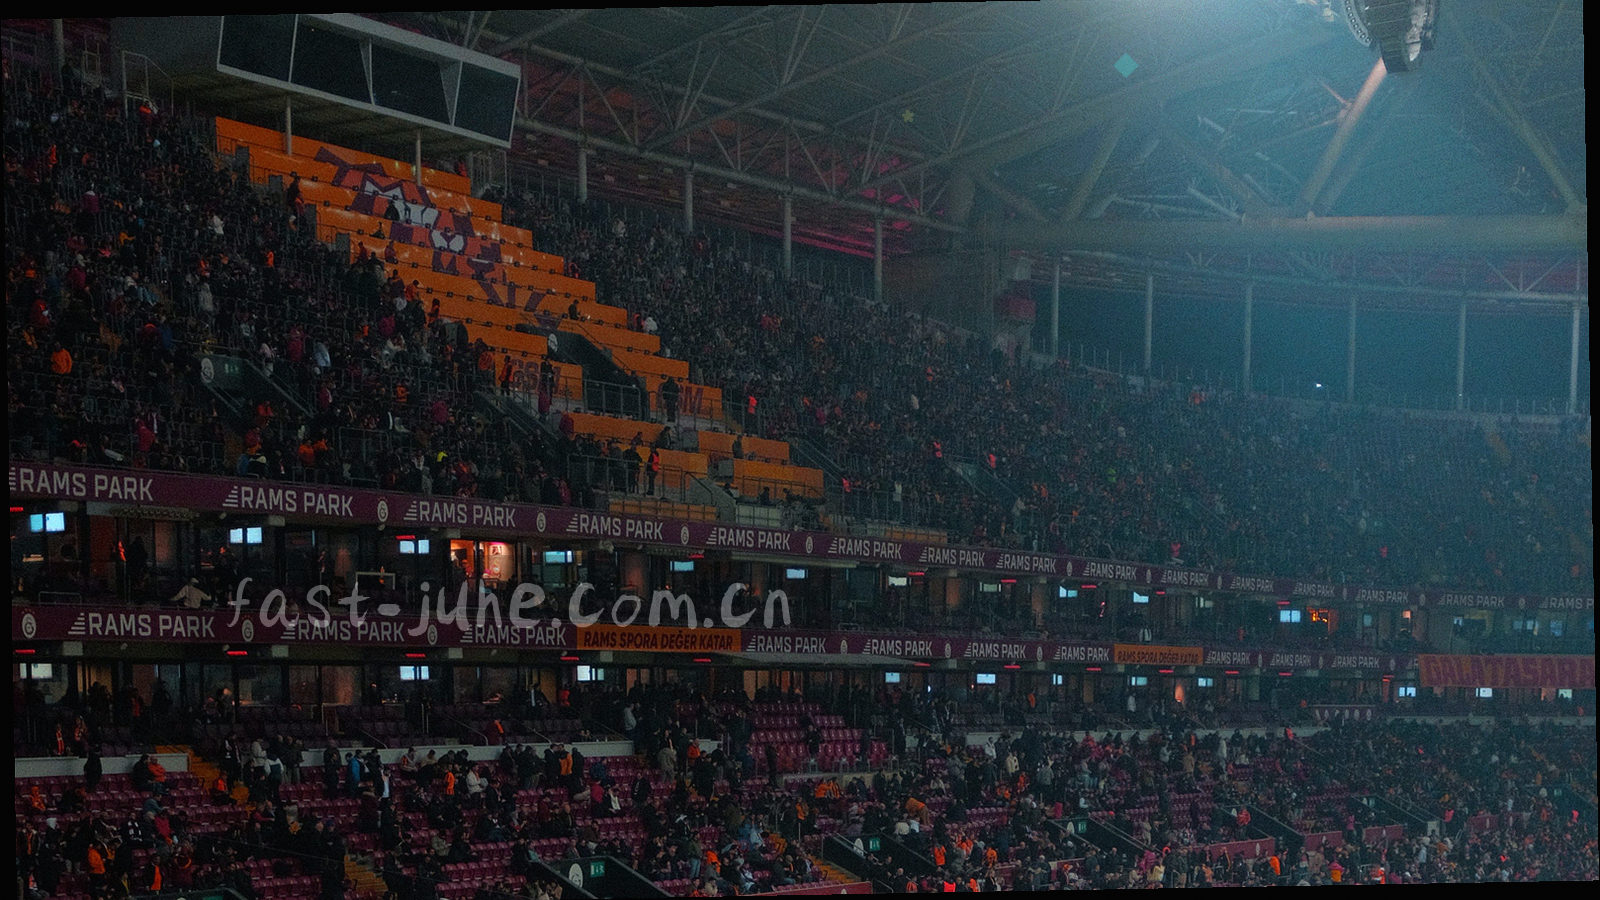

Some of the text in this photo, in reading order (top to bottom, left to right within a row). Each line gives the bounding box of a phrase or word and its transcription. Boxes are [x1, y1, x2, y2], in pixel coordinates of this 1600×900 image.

[20, 467, 154, 501] RAMS PARK
[241, 486, 353, 517] RAMS PARK
[419, 501, 516, 528] RAMS PARK
[579, 514, 664, 540] RAMS PARK
[718, 527, 790, 551] RAMS PARK
[838, 538, 902, 560] RAMS PARK
[928, 547, 985, 567] RAMS PARK
[1004, 554, 1056, 573] RAMS PARK
[1090, 562, 1137, 580] RAMS PARK
[1167, 570, 1209, 586] RAMS PARK
[1236, 576, 1274, 592] RAMS PARK
[1297, 582, 1335, 597] RAMS PARK
[1361, 588, 1408, 602] RAMS PARK
[1446, 593, 1505, 606] RAMS PARK
[1550, 598, 1583, 609] RAMS
[89, 612, 215, 638] RAMS PARK
[298, 617, 405, 642] RAMS PARK
[475, 624, 566, 646] RAMS PARK
[584, 630, 733, 650] RAMS SPORA DEĞER KATAR
[757, 635, 826, 654] RAMS PARK
[871, 638, 933, 656] RAMS PARK
[972, 643, 1026, 659] RAMS PARK
[1061, 646, 1109, 661] RAMS PARK
[1118, 651, 1136, 662] RAMS
[1211, 651, 1250, 665] RAMS PARK
[1275, 654, 1312, 667] RAMS PARK
[1337, 656, 1380, 668] RAMS PARK
